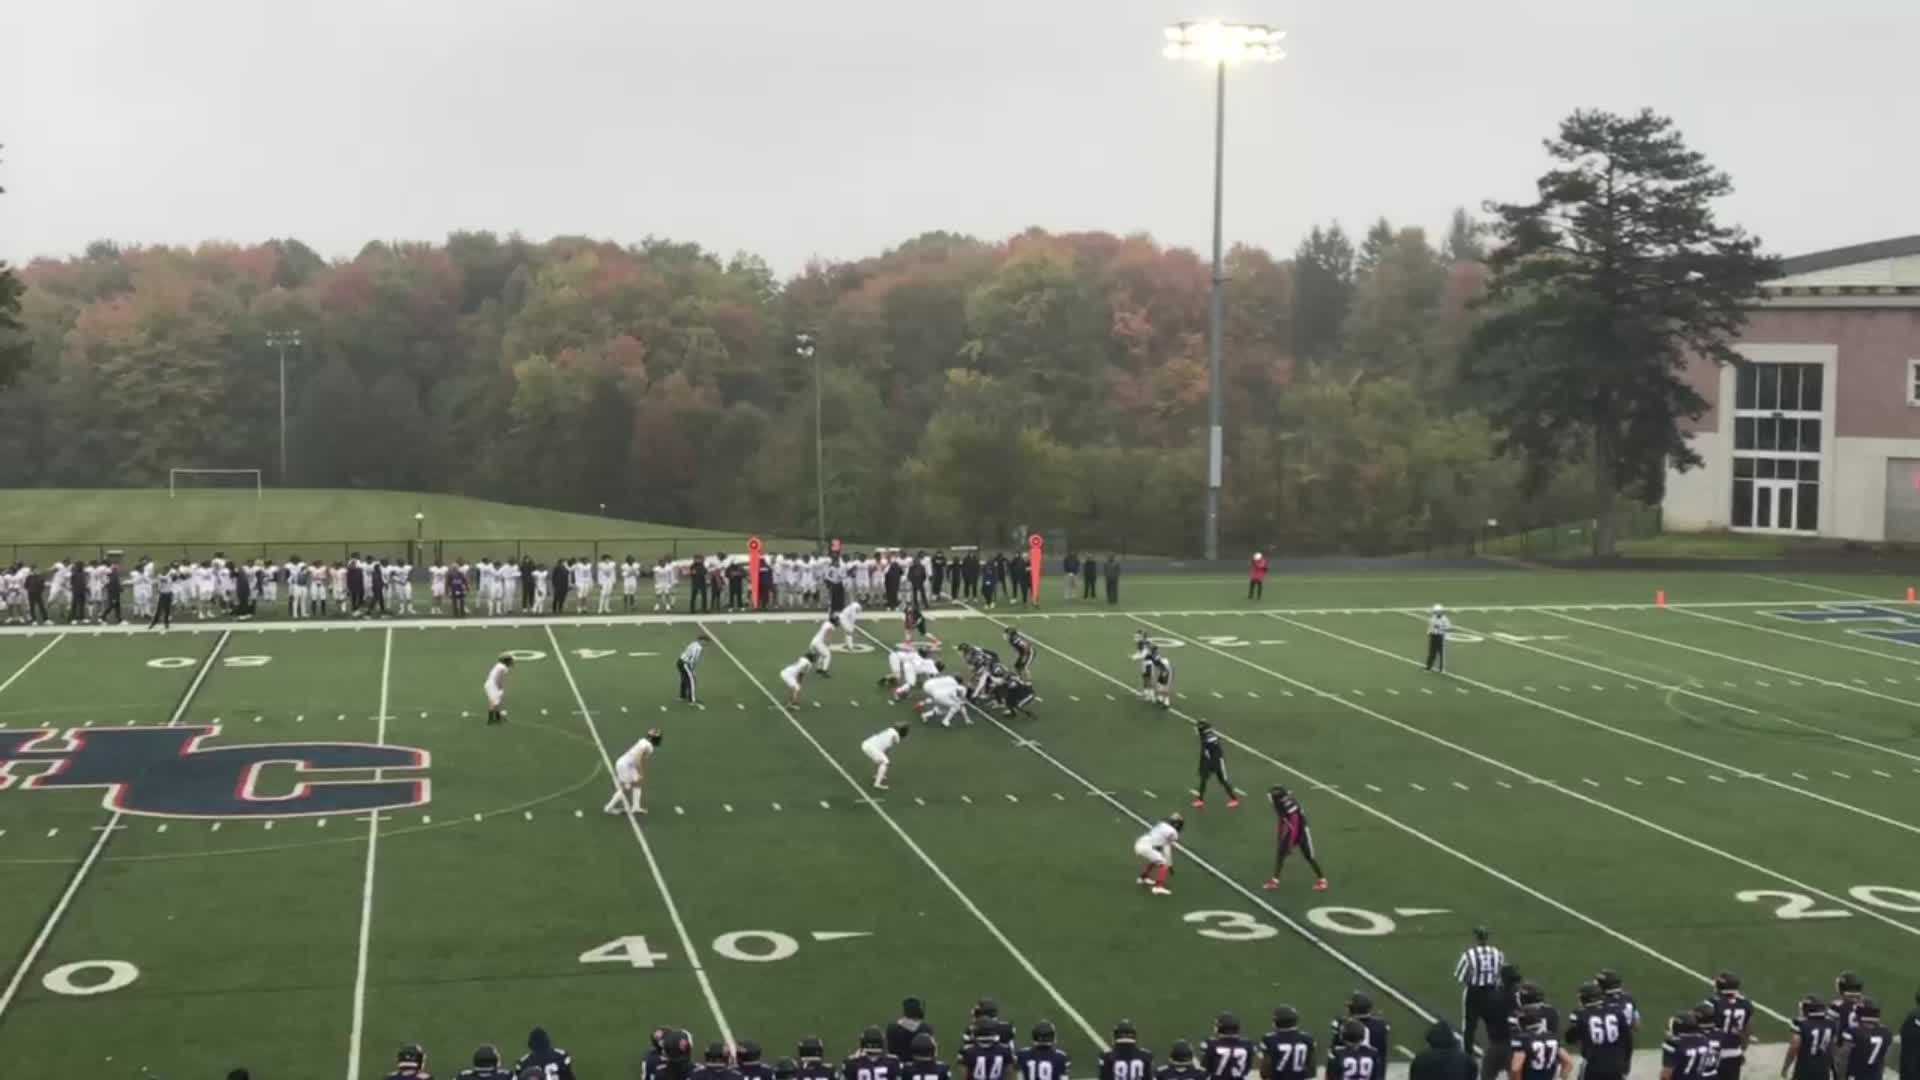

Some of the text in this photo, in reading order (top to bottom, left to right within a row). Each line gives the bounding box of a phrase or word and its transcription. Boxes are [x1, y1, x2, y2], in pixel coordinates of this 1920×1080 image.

[1183, 906, 1396, 940] 30
[578, 930, 799, 968] 40
[1589, 1014, 1619, 1044] 66
[1723, 1008, 1746, 1034] 13
[1216, 1046, 1248, 1077] 73
[1276, 1043, 1308, 1071] 70
[1531, 1039, 1559, 1070] 37
[1868, 1035, 1883, 1065] 7
[974, 1055, 1003, 1080] 44
[1343, 1056, 1374, 1080] 29
